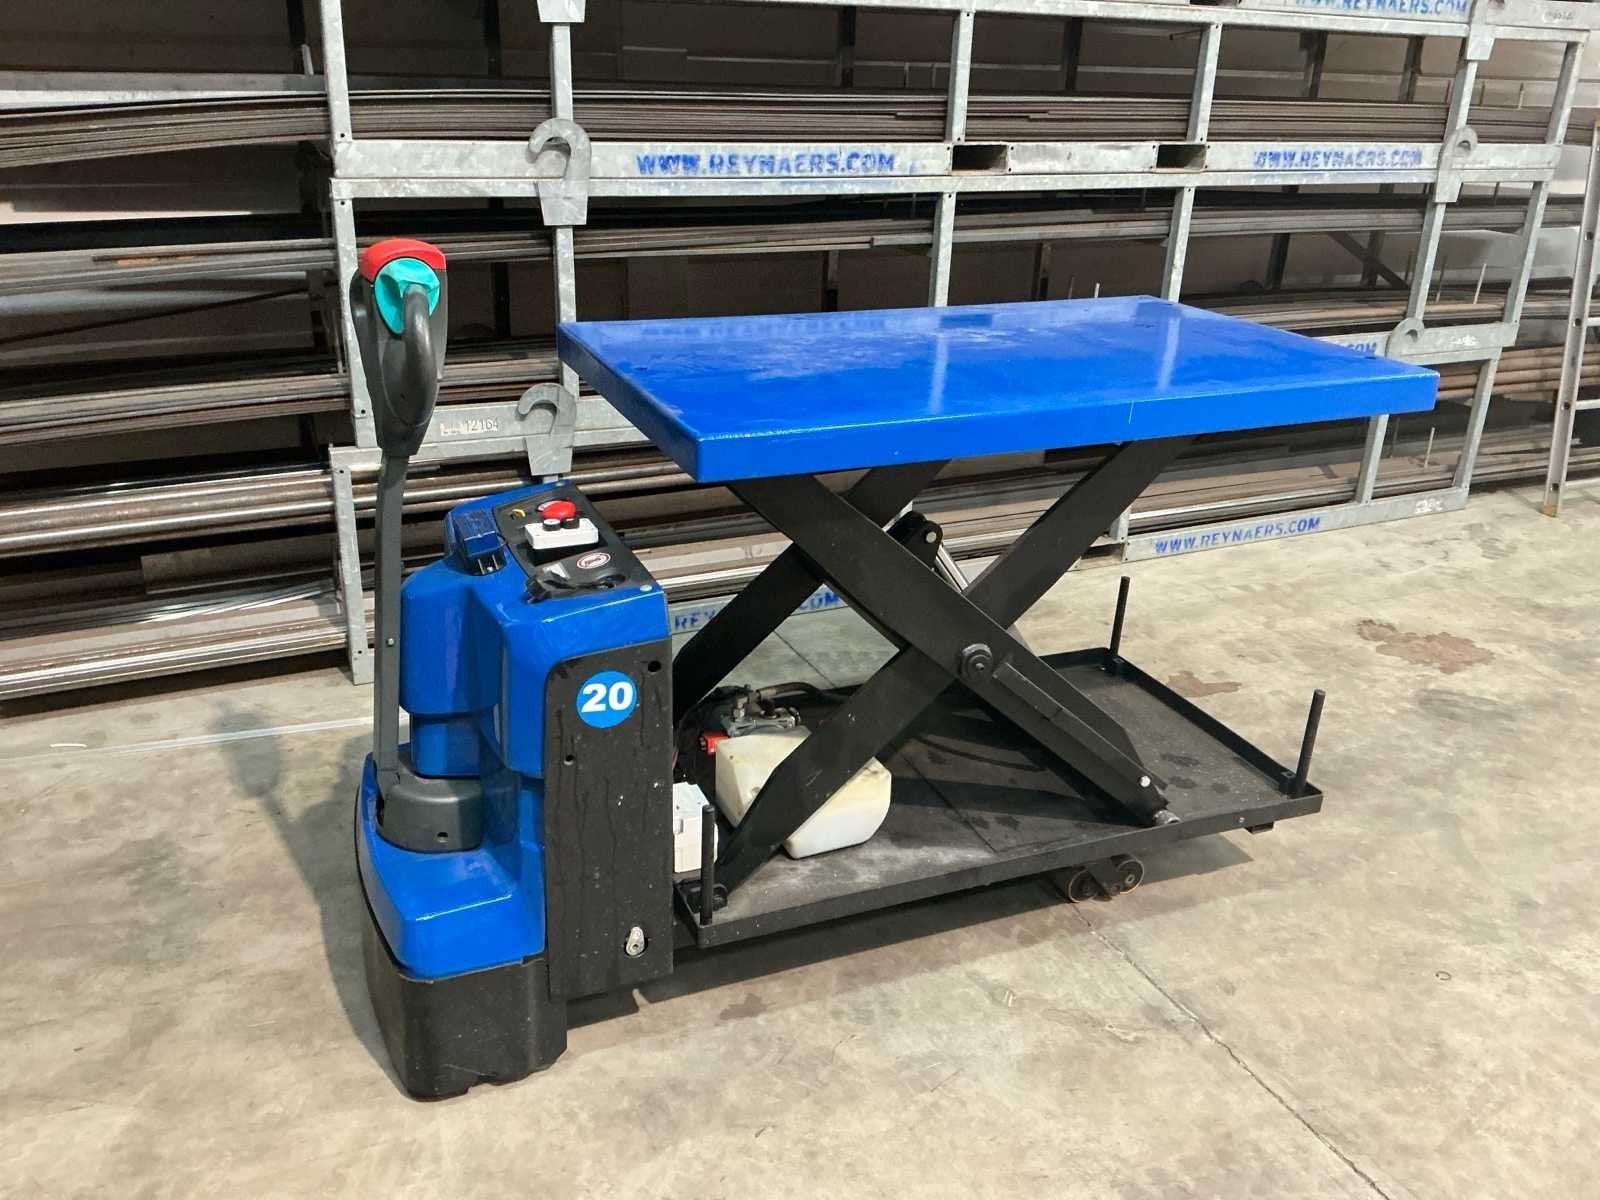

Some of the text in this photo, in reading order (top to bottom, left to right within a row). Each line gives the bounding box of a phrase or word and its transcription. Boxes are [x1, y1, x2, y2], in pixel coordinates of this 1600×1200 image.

[636, 152, 895, 175] WWW.REYNAERS.COM
[1155, 517, 1320, 553] WWW.REYNAERS.COM
[581, 681, 633, 713] 20
